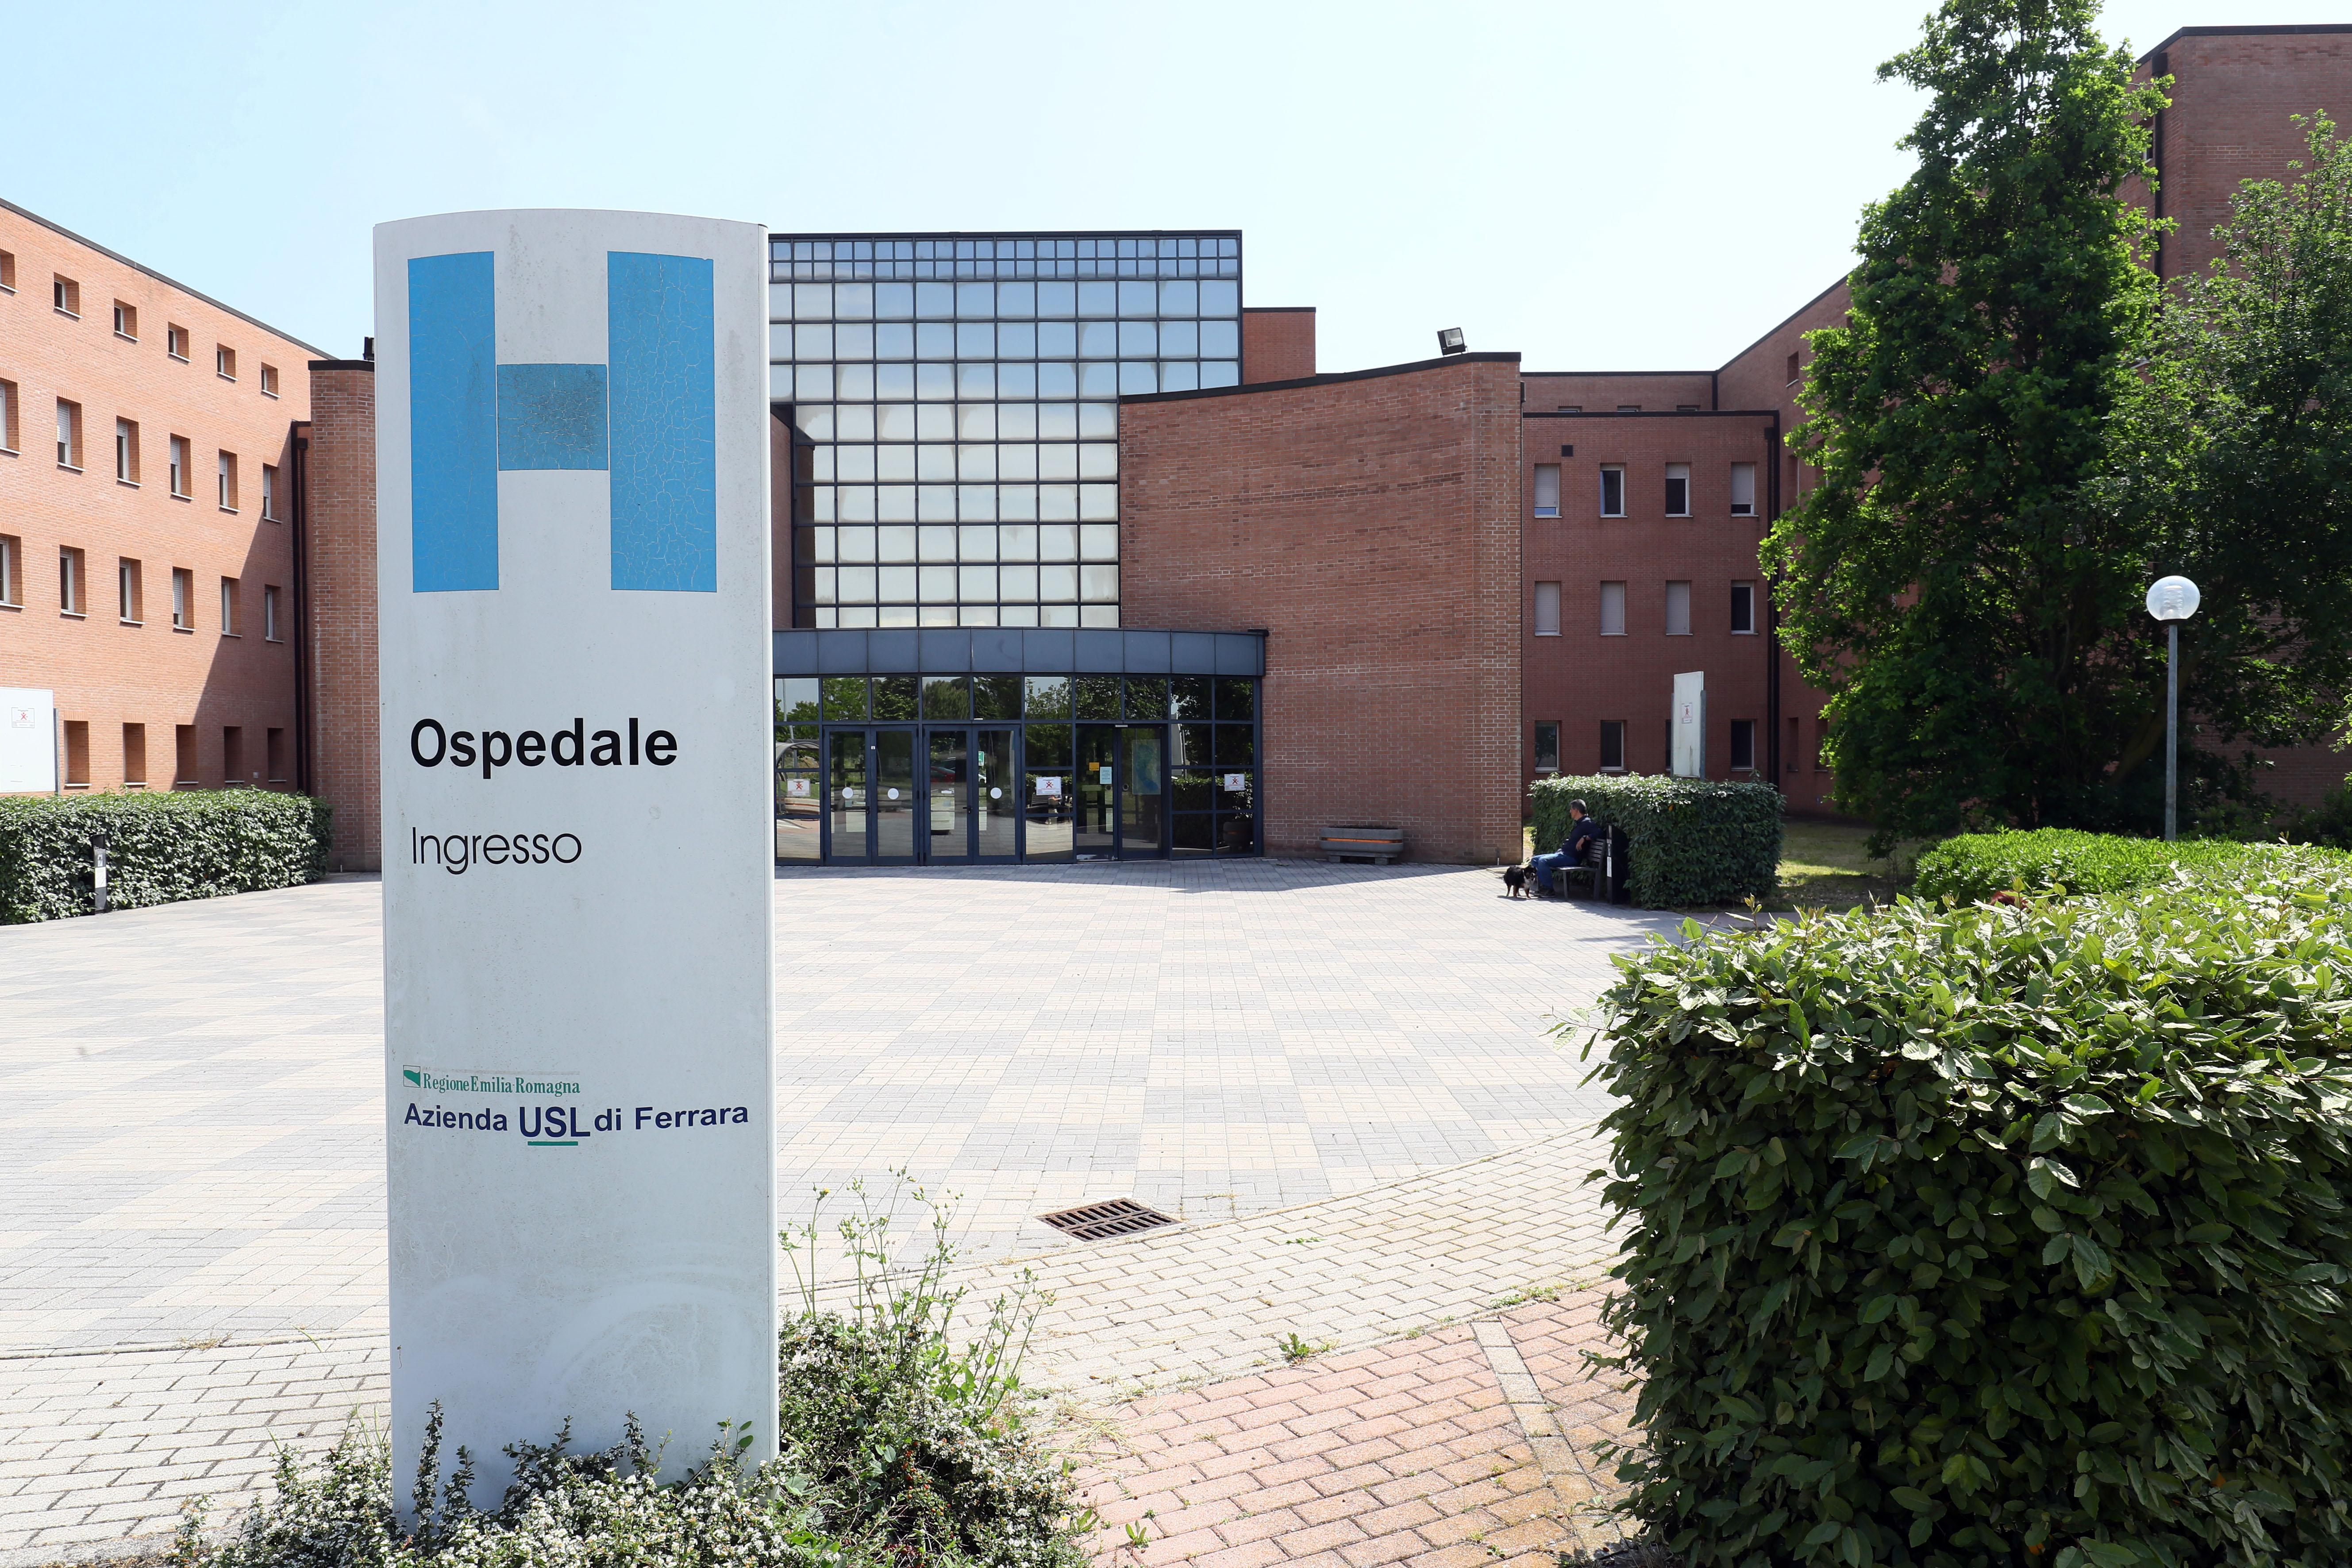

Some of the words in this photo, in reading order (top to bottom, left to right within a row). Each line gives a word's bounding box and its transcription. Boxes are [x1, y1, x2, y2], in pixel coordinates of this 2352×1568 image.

[408, 250, 717, 593] H
[410, 717, 678, 780] Ospedale
[412, 826, 582, 875] Ingresso
[404, 1102, 508, 1132] Azienda
[519, 1106, 591, 1138] USL
[594, 1107, 622, 1132] di
[635, 1106, 749, 1130] Ferrara
